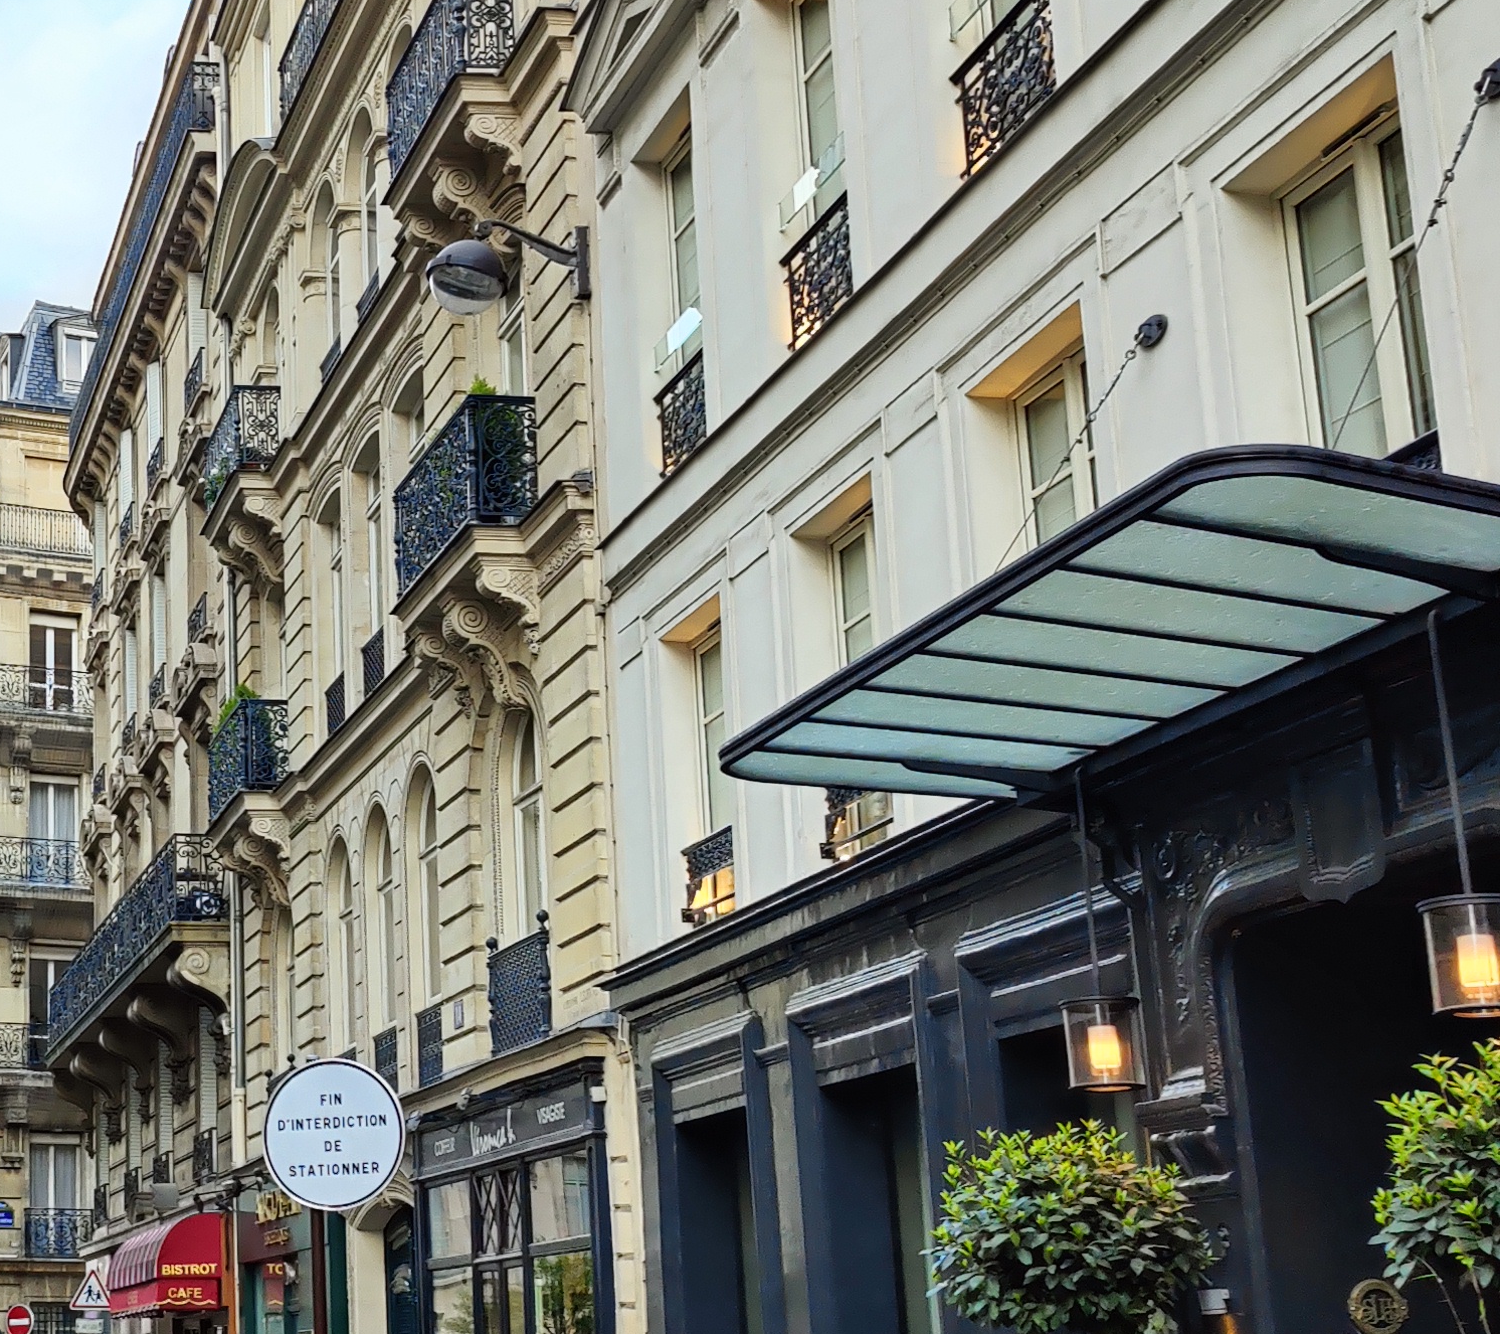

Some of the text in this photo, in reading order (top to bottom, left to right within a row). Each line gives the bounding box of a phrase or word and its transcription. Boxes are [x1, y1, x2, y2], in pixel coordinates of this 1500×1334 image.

[320, 1093, 343, 1106] FIN
[277, 1114, 388, 1132] D'INTERDICTION
[324, 1140, 343, 1152] DE
[289, 1161, 380, 1178] STATIONNER
[161, 1263, 218, 1276] BISTROT
[168, 1287, 203, 1299] CAFE
